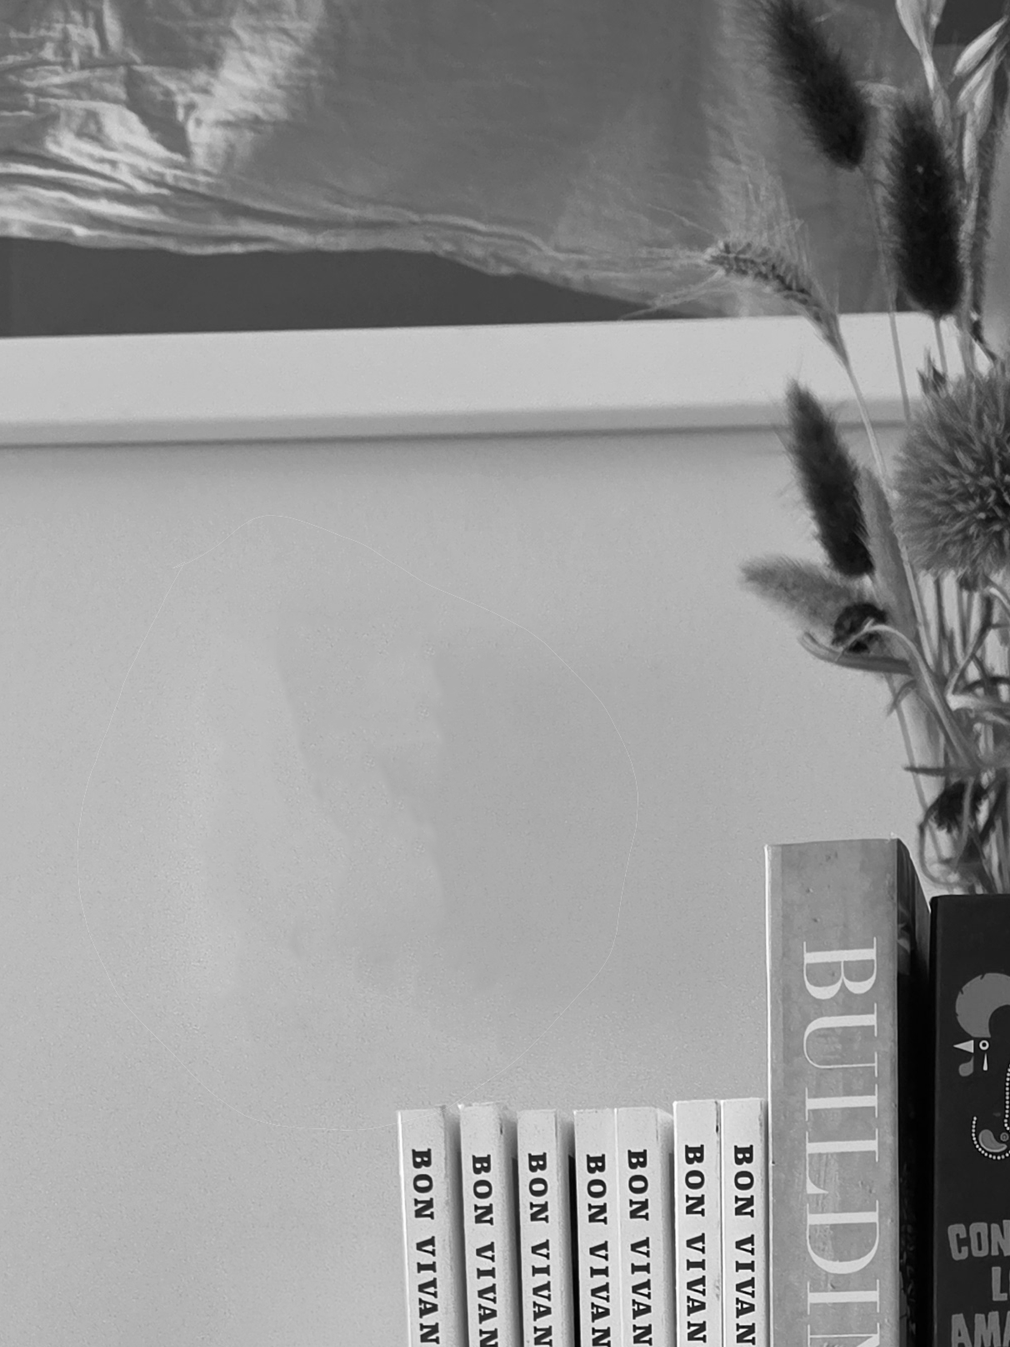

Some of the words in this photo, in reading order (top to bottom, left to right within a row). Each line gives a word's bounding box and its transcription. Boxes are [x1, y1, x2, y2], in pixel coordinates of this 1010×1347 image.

[412, 1148, 434, 1220] BON
[472, 1154, 494, 1225] BON
[528, 1152, 549, 1224] BON
[586, 1154, 607, 1224] BON
[627, 1149, 649, 1221] BON
[684, 1144, 705, 1216] BON
[734, 1145, 754, 1217] BON
